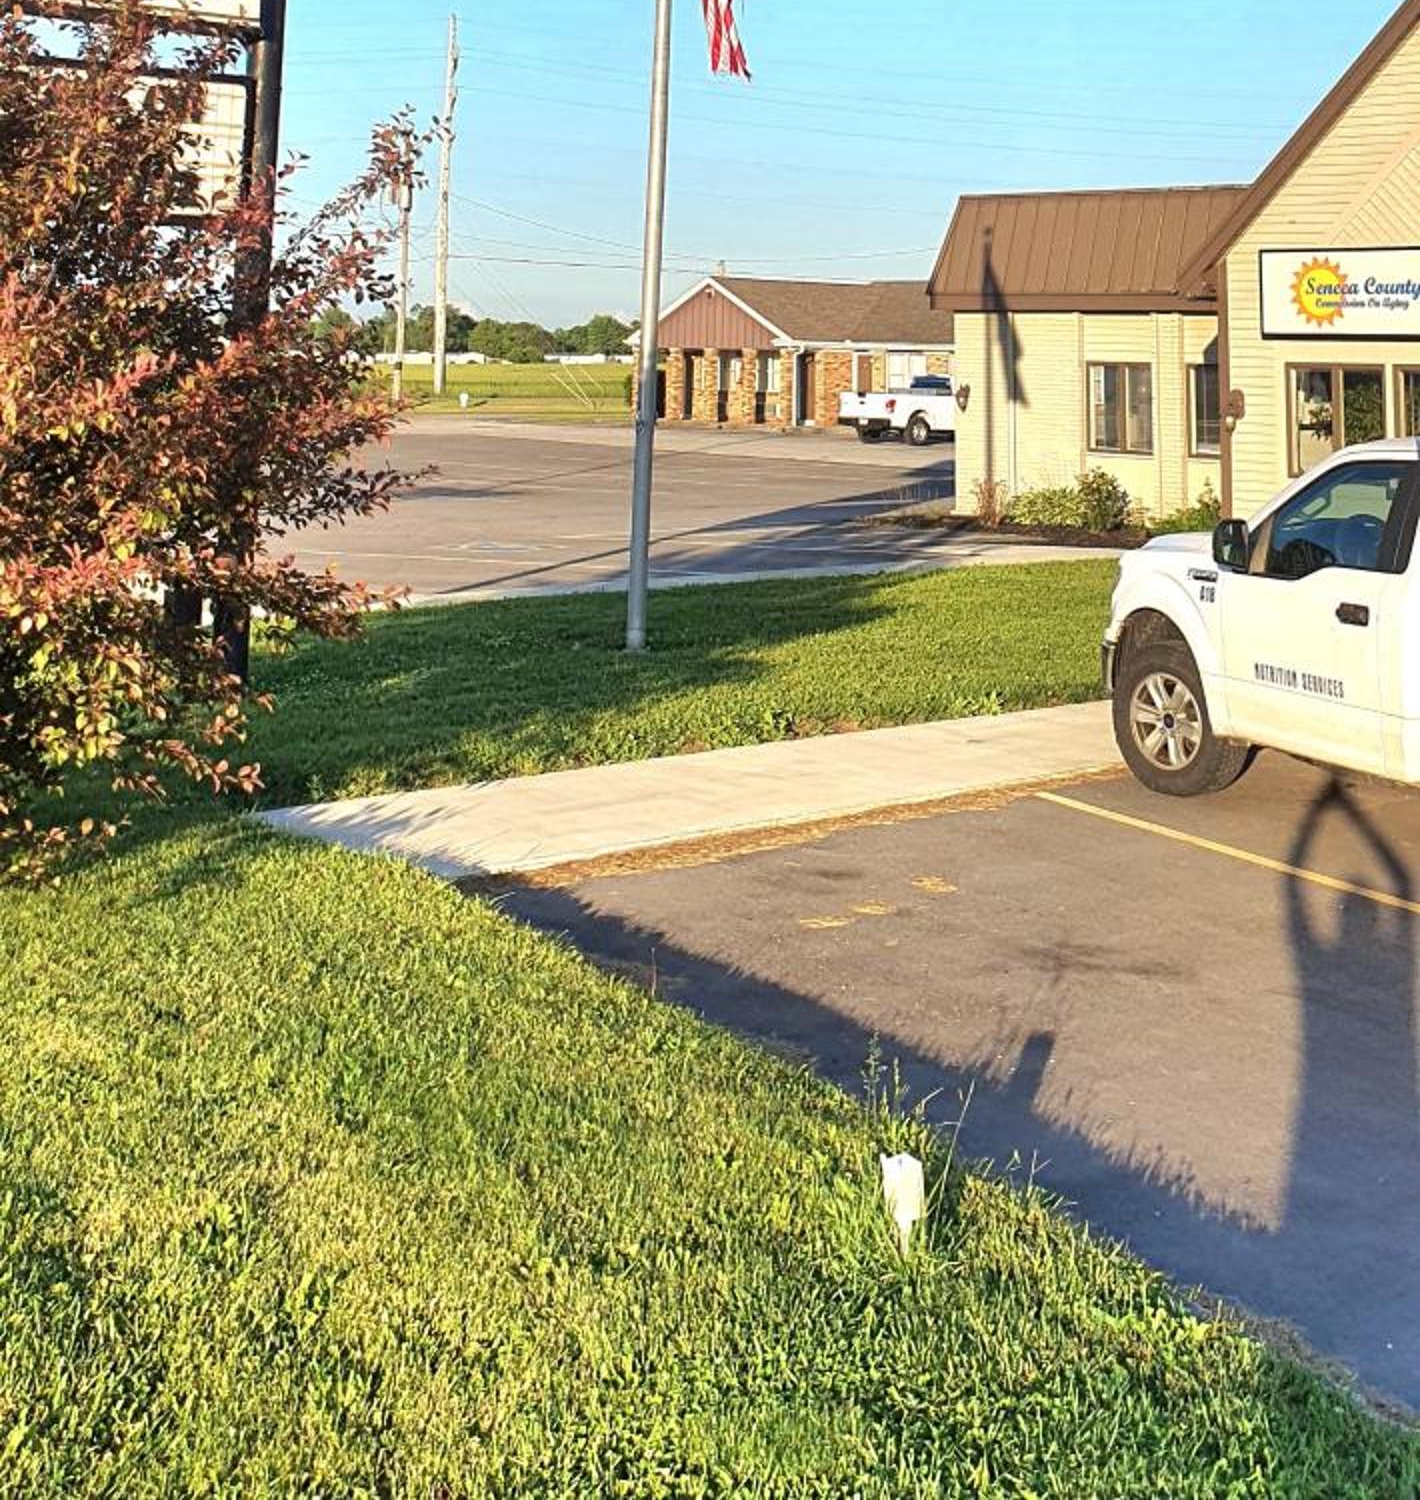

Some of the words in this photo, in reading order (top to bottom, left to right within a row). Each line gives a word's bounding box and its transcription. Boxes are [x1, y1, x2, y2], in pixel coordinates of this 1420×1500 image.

[1306, 277, 1360, 296] Seneca
[1364, 276, 1420, 300] County
[1254, 662, 1298, 689] NUTRITION
[1301, 672, 1344, 699] SERVICES
